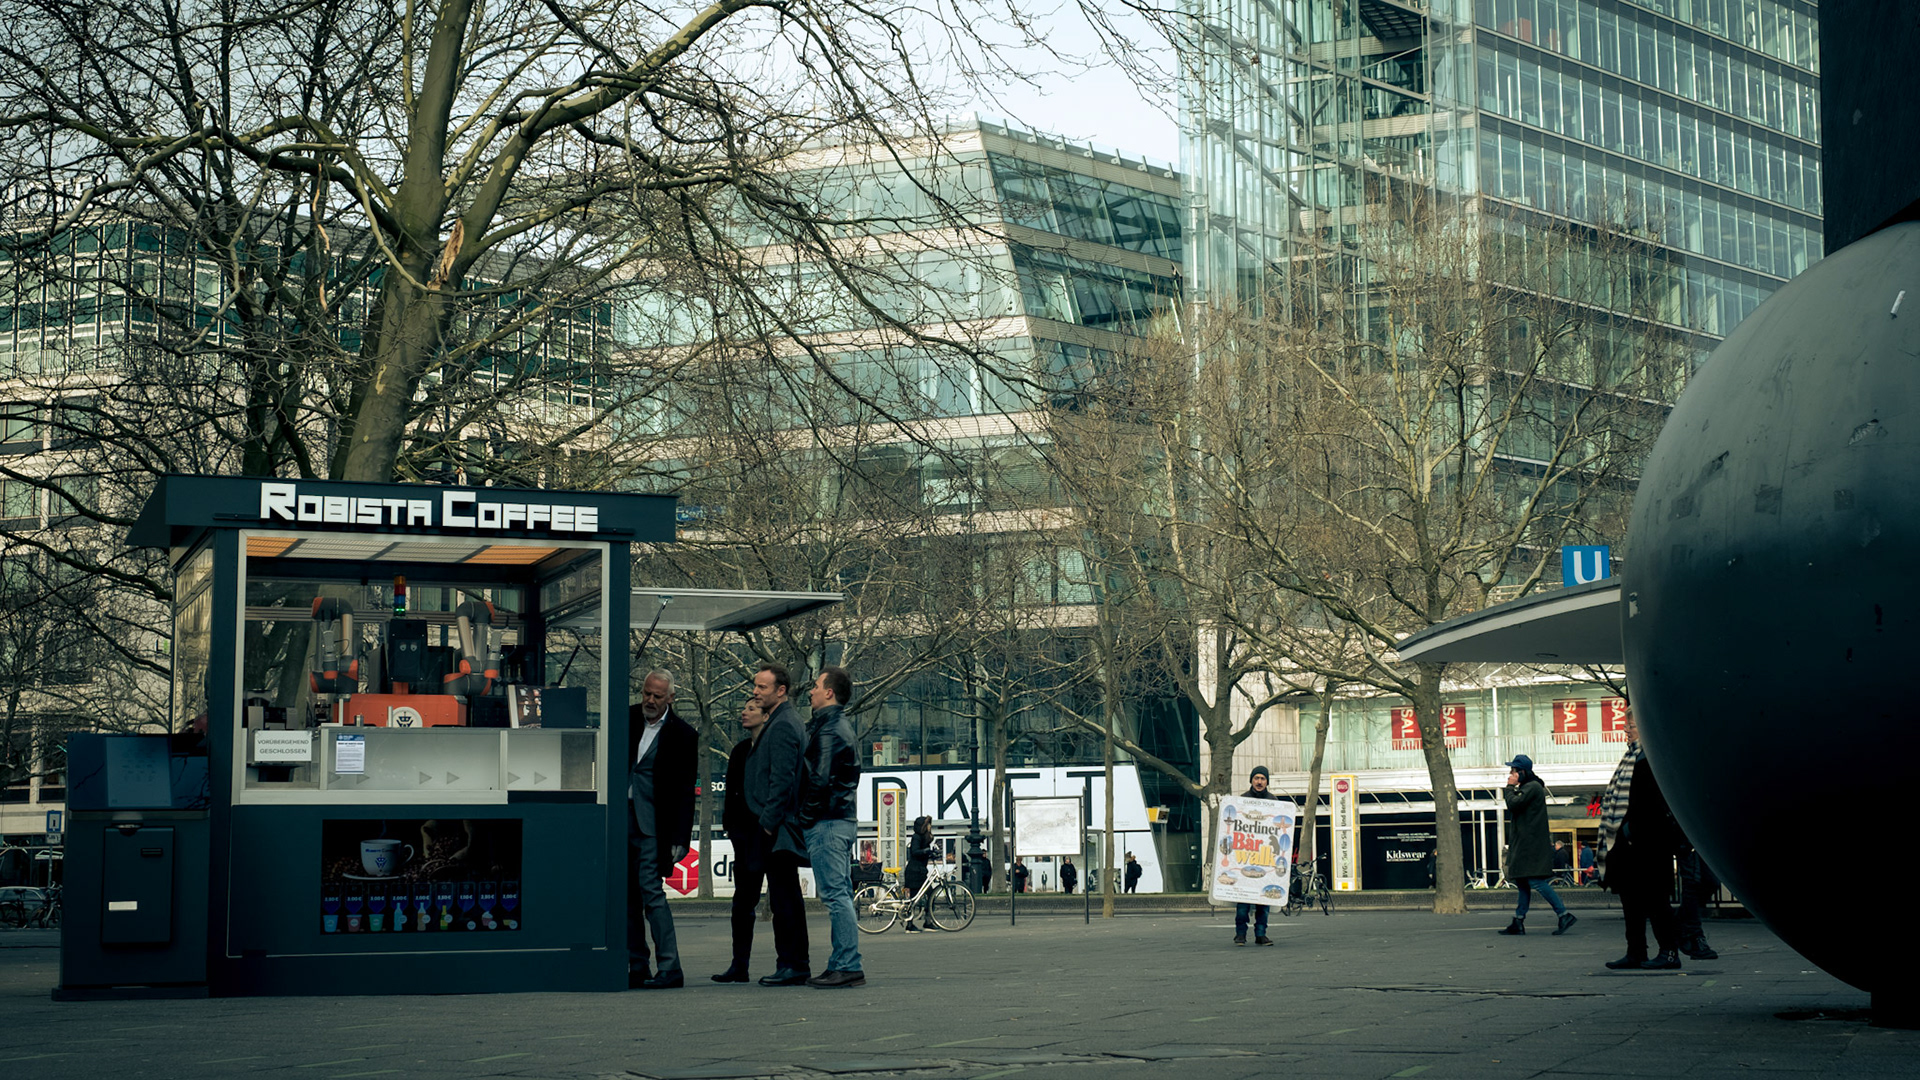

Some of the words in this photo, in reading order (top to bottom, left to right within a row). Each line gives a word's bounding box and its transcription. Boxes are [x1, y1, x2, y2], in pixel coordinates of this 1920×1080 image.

[260, 482, 433, 527] ROBISTA
[442, 490, 599, 533] COFFEE
[1573, 551, 1603, 585] U
[257, 737, 309, 745] VORÜBERGEHEND
[259, 747, 307, 755] GESCHLOSSEN
[1233, 819, 1281, 836] Berliner
[1232, 832, 1263, 851] Bär
[1235, 845, 1277, 867] walk
[1386, 850, 1427, 859] Kidswear
